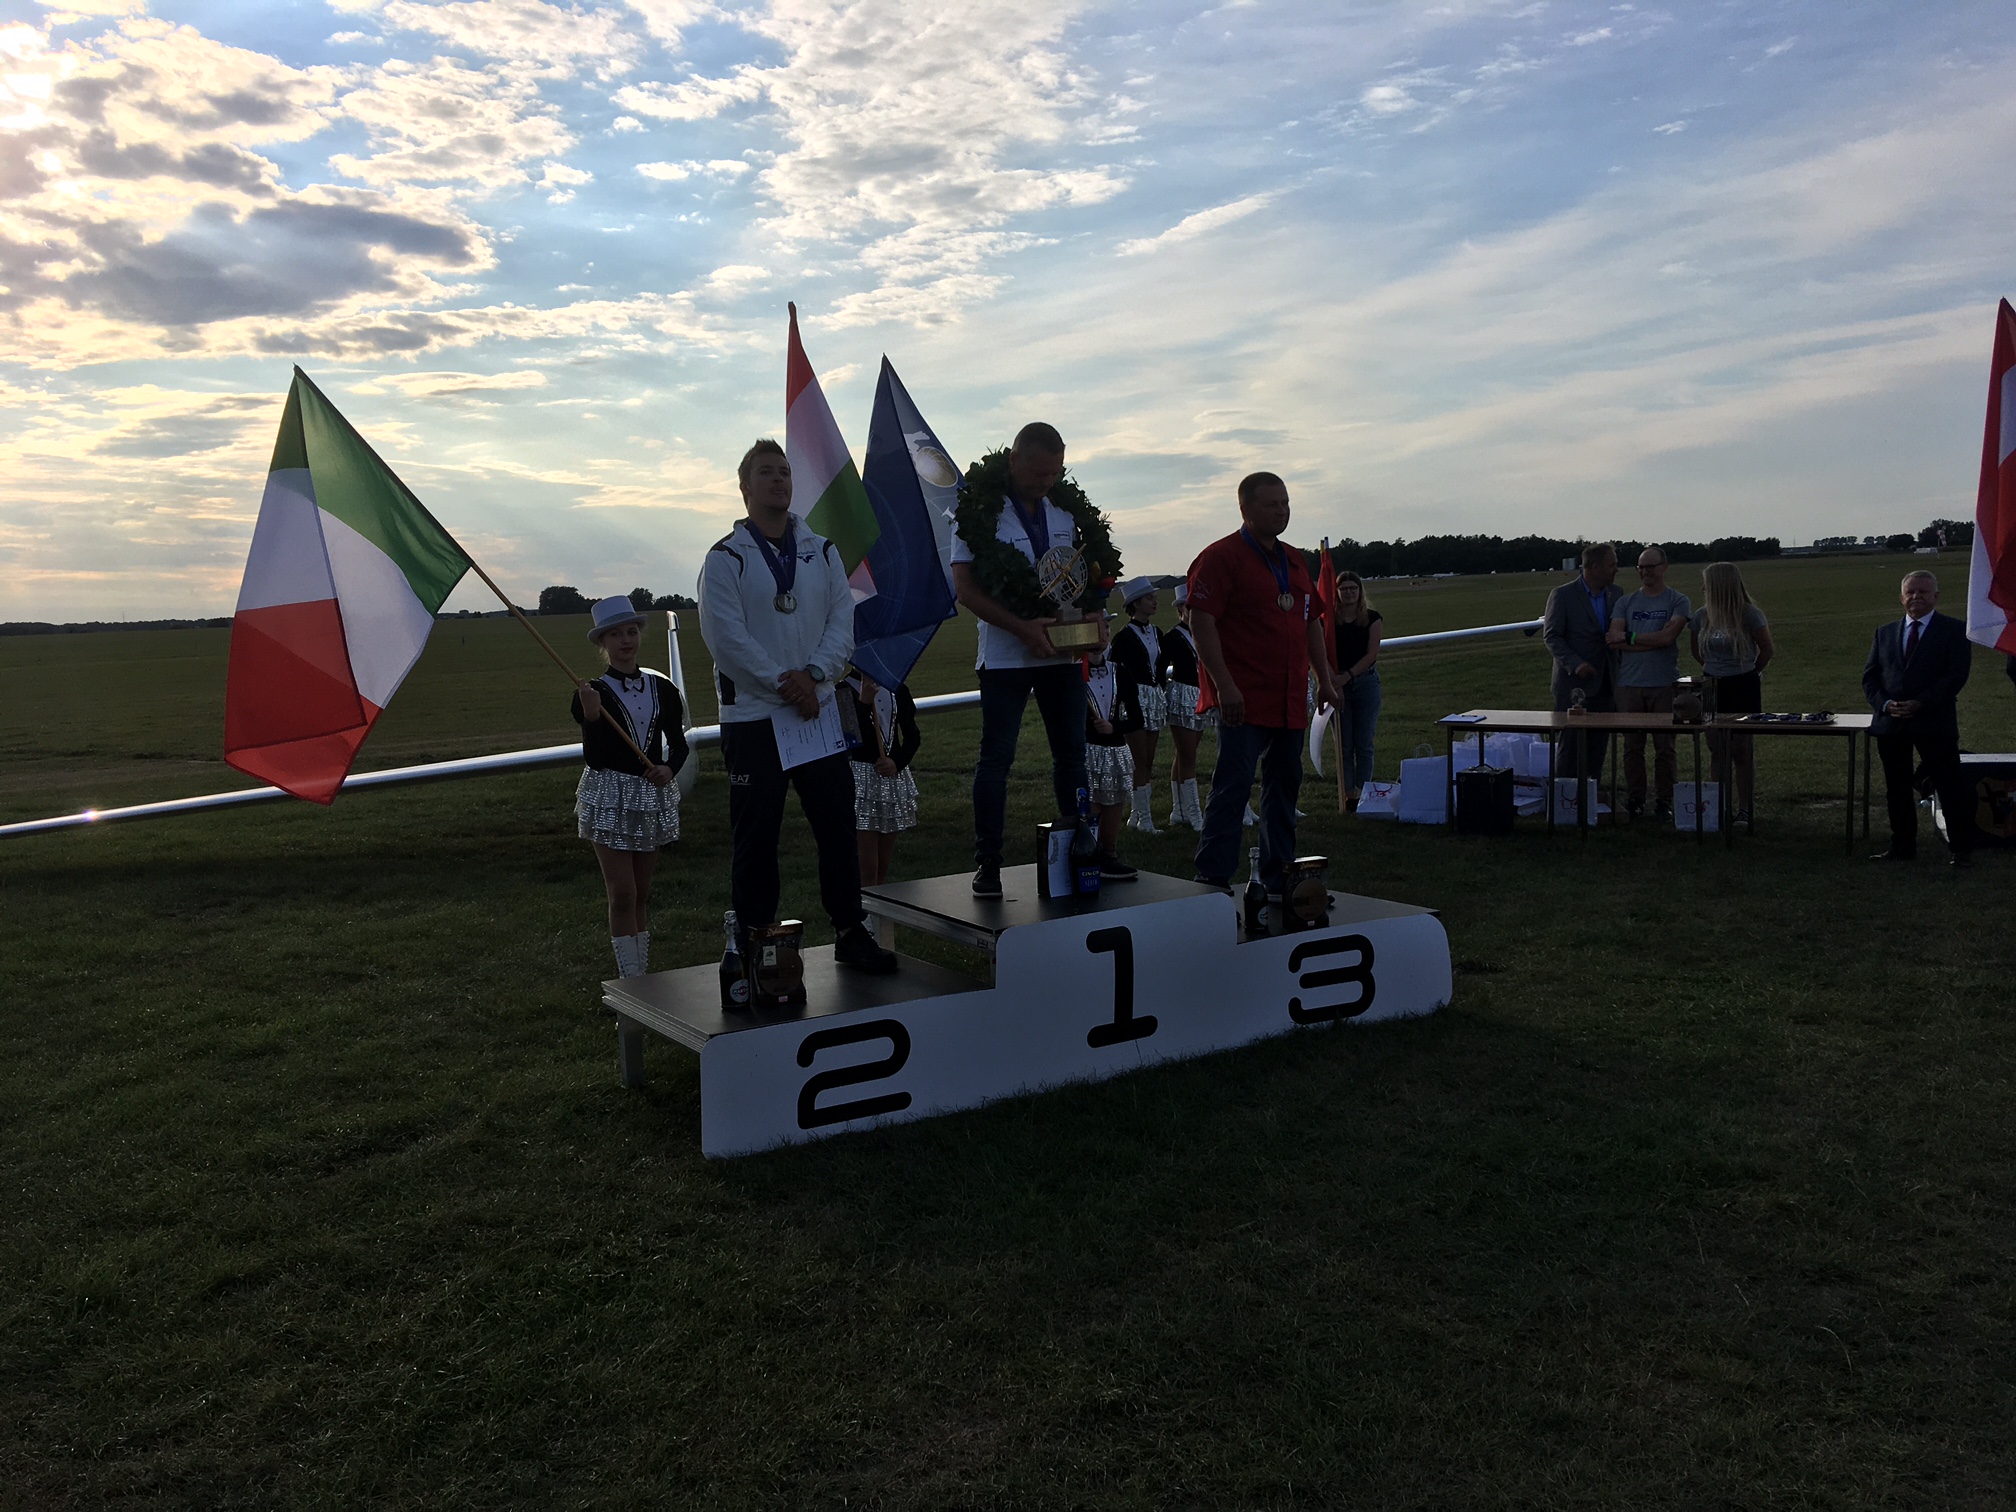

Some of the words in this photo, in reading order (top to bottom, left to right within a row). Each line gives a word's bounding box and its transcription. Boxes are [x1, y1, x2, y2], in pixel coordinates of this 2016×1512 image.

[731, 774, 750, 783] EA7
[1087, 927, 1158, 1048] 1
[1289, 934, 1375, 1024] 3
[797, 1019, 911, 1129] 2
